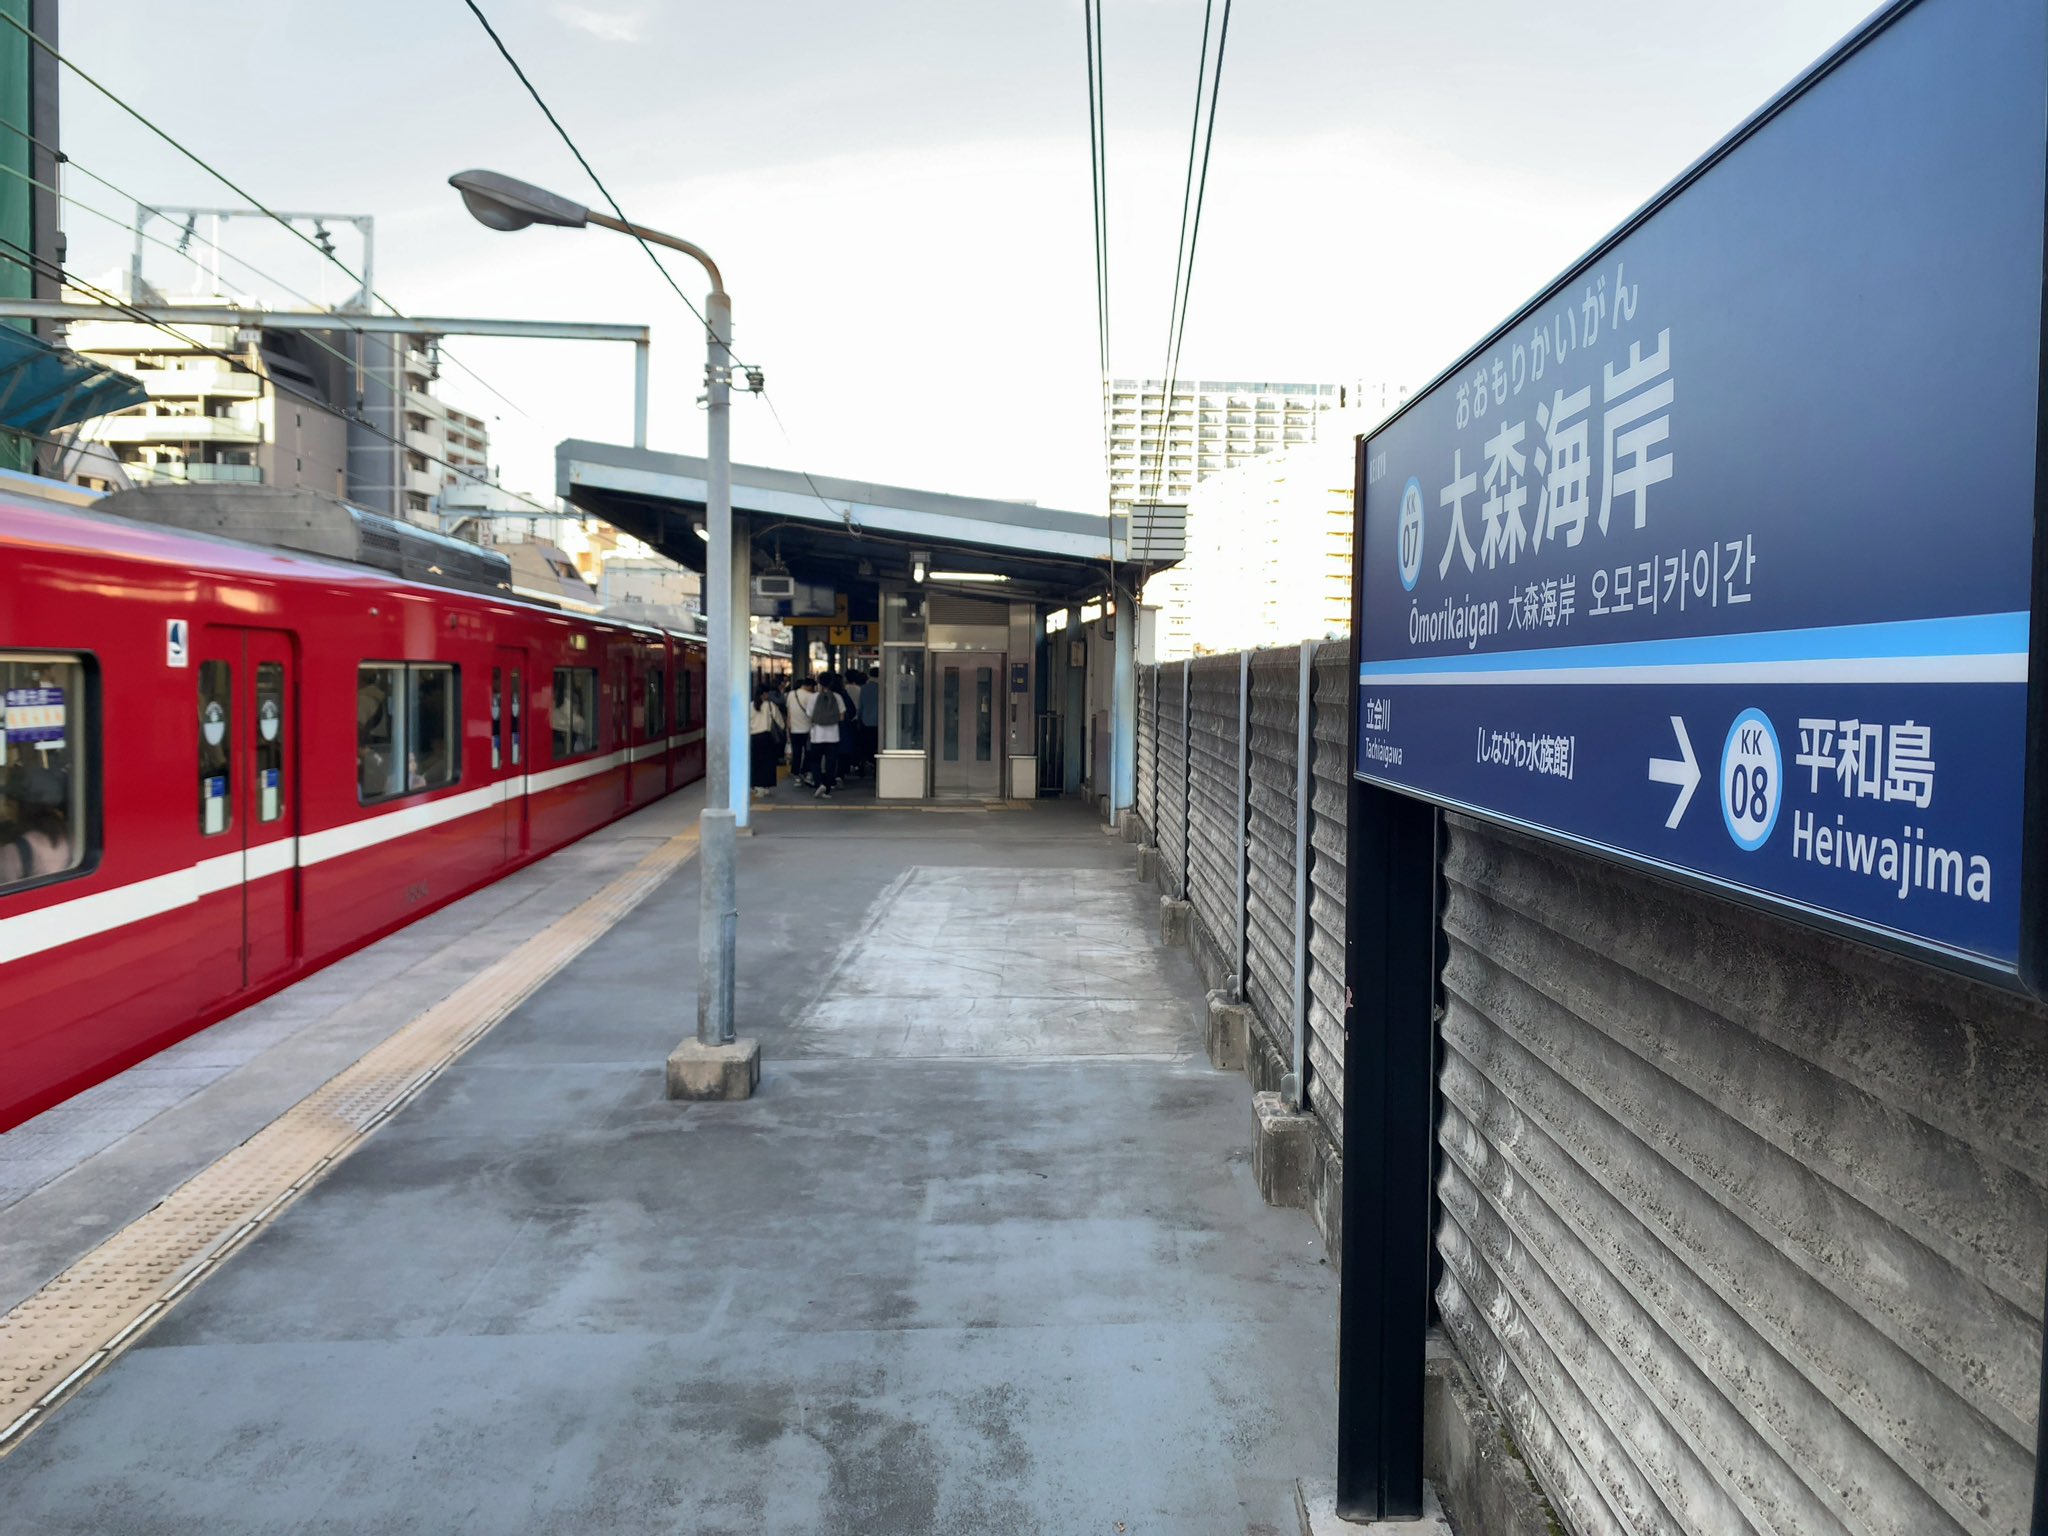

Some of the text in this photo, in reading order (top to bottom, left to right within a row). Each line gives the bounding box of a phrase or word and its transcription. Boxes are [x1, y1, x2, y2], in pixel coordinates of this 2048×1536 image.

[1455, 262, 1639, 431] おおもりかいがん
[1438, 327, 1675, 581] 大森海岸
[1406, 492, 1416, 517] KK
[1402, 519, 1419, 569] 07
[1409, 533, 1757, 650] Ōmorikaigan 大森海岸 오모리카이간
[1365, 697, 1392, 733] 立会川
[1740, 728, 1763, 757] KK
[1365, 736, 1403, 769] Tachiaigawa
[1795, 717, 1936, 809] 平和島
[1731, 763, 1769, 824] 08
[1792, 809, 1991, 903] Heiwajima
